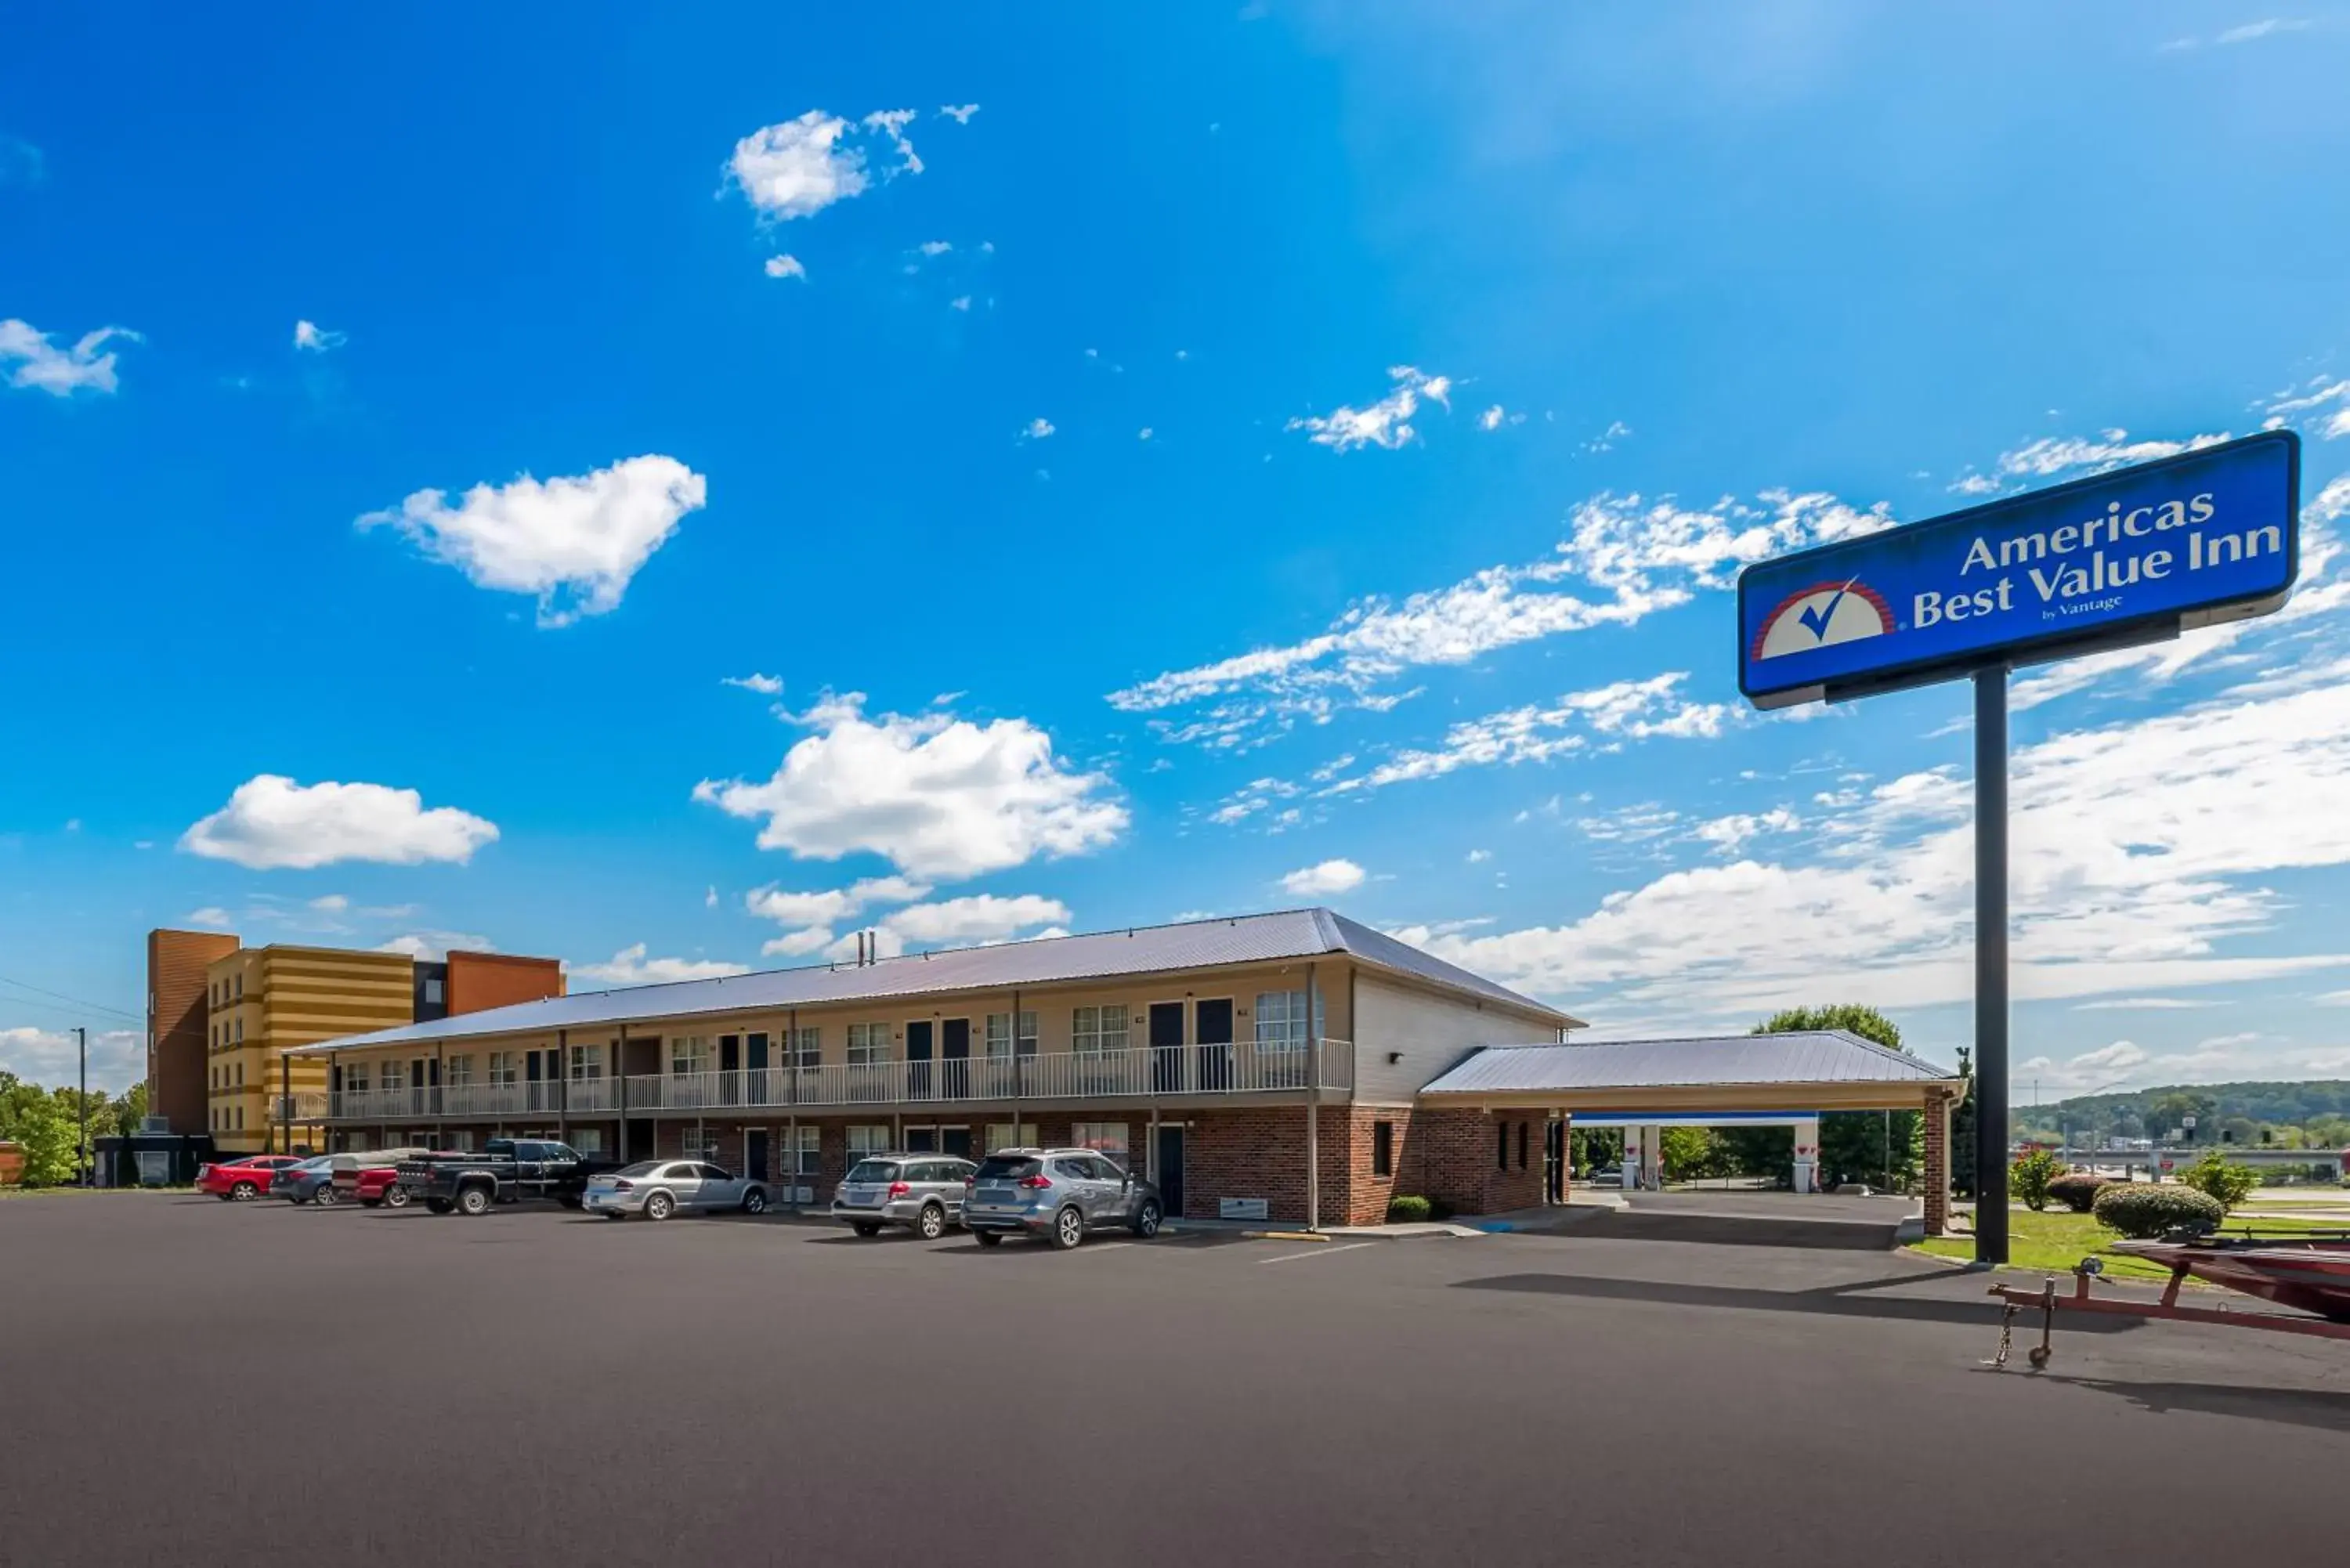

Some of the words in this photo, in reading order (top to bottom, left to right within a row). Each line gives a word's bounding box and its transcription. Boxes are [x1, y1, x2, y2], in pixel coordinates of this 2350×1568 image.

[1960, 493, 2214, 576] Americas
[1914, 577, 2015, 629] Best
[2028, 550, 2173, 602] Value
[2189, 526, 2280, 570] Inn
[2042, 610, 2055, 620] by
[2059, 596, 2124, 615] Vantage
